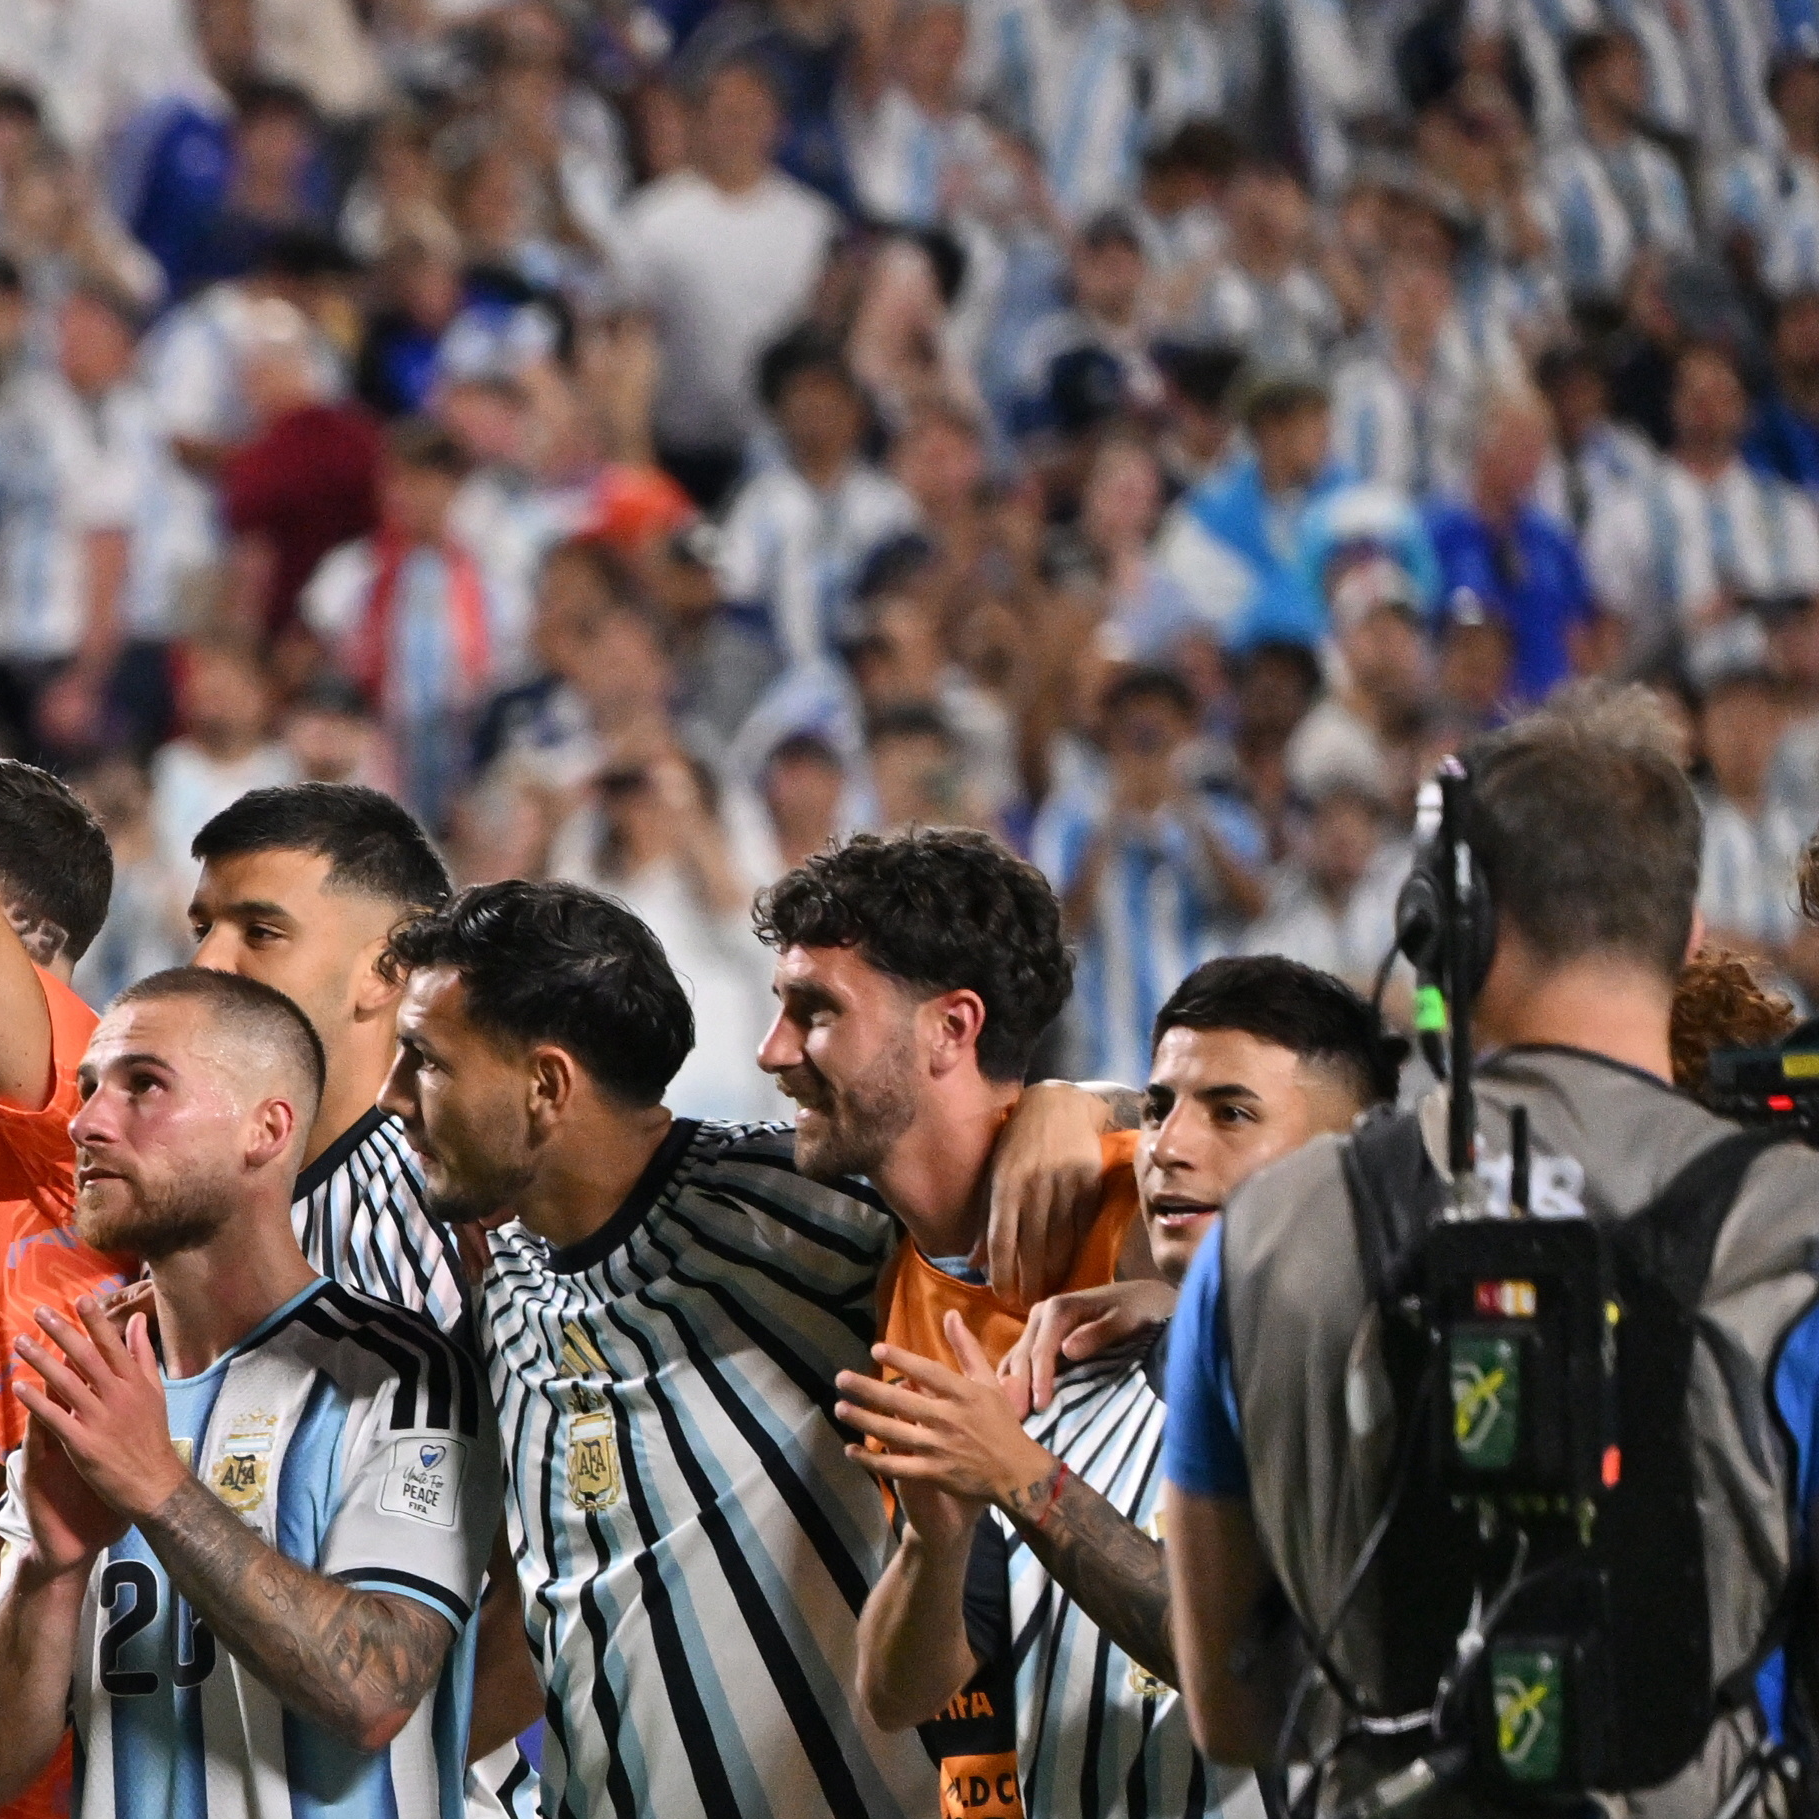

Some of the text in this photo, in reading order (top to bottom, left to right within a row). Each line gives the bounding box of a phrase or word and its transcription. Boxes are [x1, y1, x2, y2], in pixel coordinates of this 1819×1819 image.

[220, 1454, 256, 1492] AFA
[578, 1439, 606, 1481] AFA
[403, 1483, 440, 1507] PEACE
[409, 1502, 428, 1514] FIFA
[936, 1691, 995, 1721] IFA
